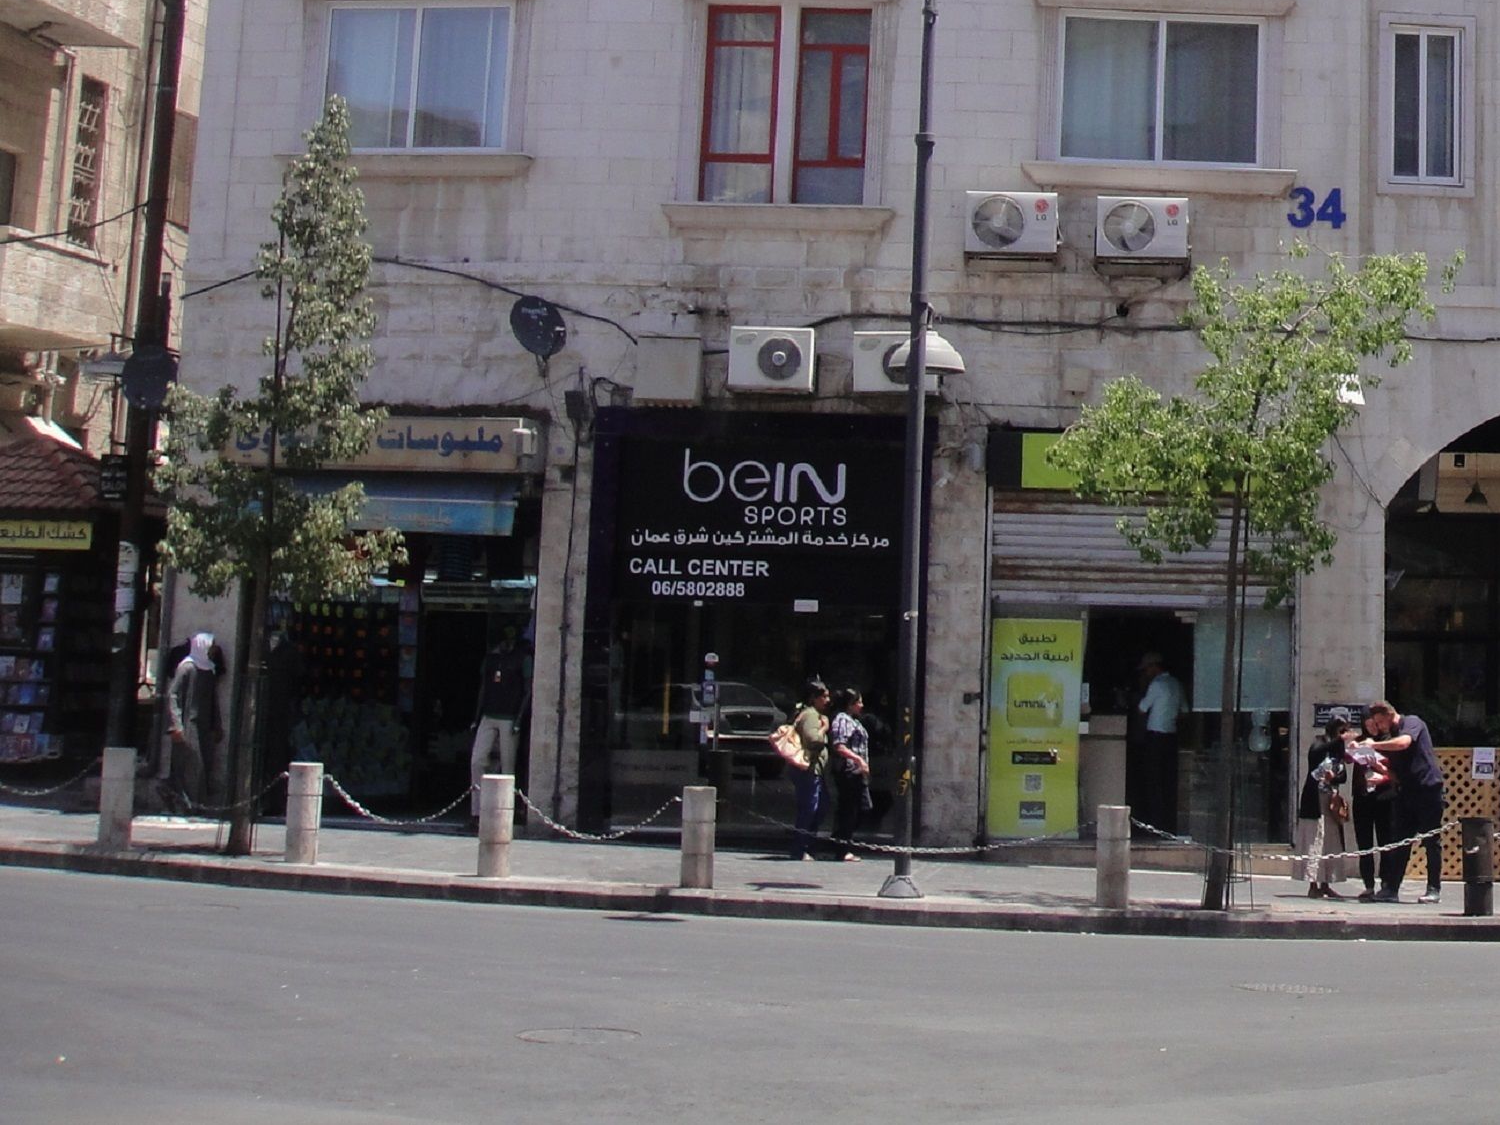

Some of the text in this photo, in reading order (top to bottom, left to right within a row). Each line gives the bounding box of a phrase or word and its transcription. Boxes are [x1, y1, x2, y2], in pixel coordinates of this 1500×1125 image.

[1286, 186, 1347, 229] 34
[376, 424, 504, 456] ملبوسات
[744, 505, 848, 526] SPORTS
[630, 527, 890, 548] مركز خدمة المشتركين شرق عمان
[629, 557, 770, 577] CALL CENTER
[1018, 632, 1057, 645] تطبيق
